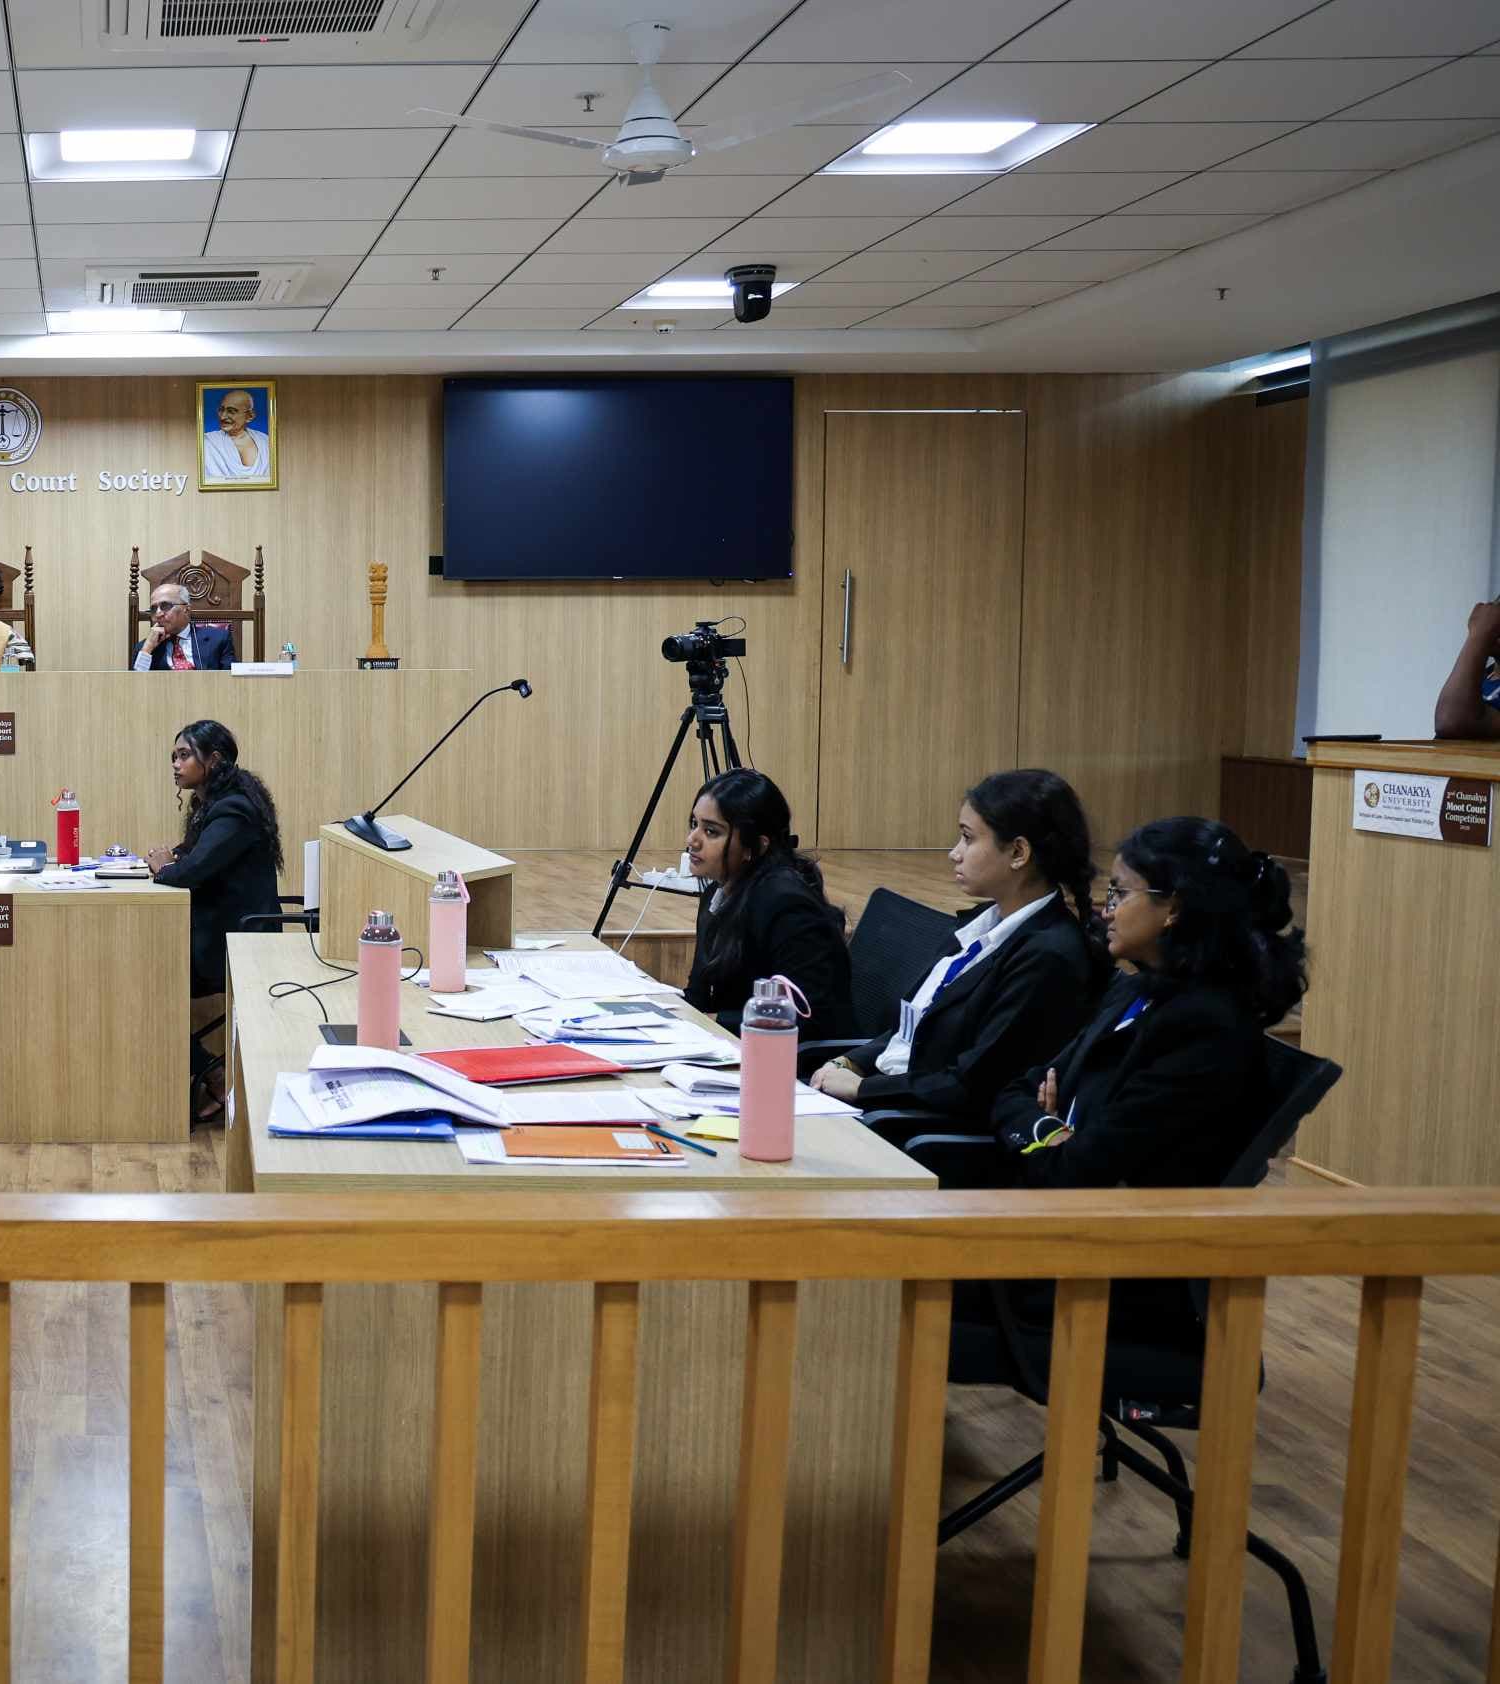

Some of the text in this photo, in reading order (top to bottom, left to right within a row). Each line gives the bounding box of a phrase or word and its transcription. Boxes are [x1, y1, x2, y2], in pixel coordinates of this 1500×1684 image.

[10, 471, 77, 493] Court
[99, 469, 189, 496] Society
[1382, 784, 1431, 798] CHANAKYA
[1382, 797, 1431, 808] UNIVERSITY
[1456, 791, 1487, 804] Chanakya
[1445, 802, 1487, 814] Moot Court
[1445, 812, 1486, 824] Competition
